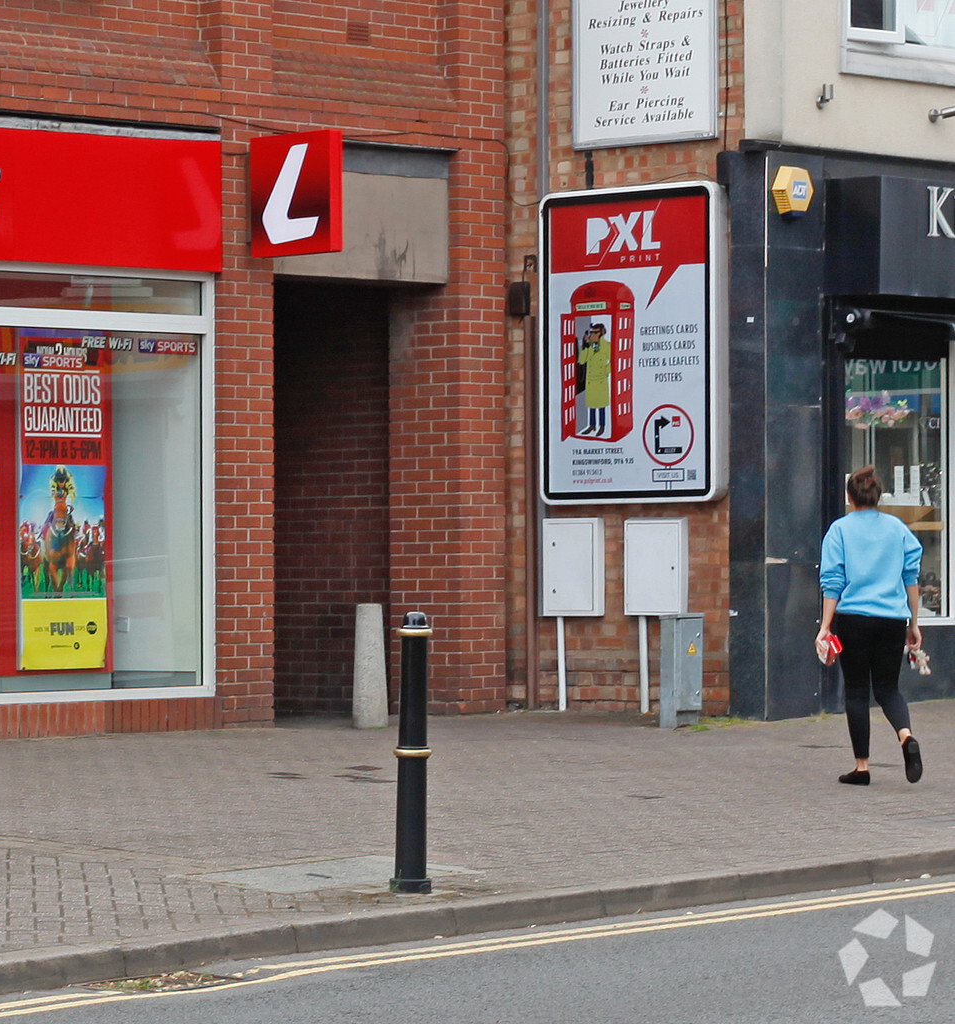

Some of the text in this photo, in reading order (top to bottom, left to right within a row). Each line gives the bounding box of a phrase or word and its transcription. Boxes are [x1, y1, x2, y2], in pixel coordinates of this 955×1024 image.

[588, 7, 703, 29] Resizing & Repairs
[600, 35, 691, 56] Watch Straps &
[599, 50, 693, 70] Batteries Fitted
[601, 65, 690, 85] While You Wait
[608, 95, 685, 112] Ear Piercing
[594, 108, 694, 128] Service Available
[262, 143, 319, 245] L
[792, 184, 807, 197] ADT
[927, 186, 955, 239] K
[586, 210, 661, 256] PXL
[620, 253, 661, 263] PRINT
[640, 323, 698, 336] GREETINGS CARDS
[81, 335, 106, 349] FREE
[139, 340, 196, 353] sky SPORTS
[642, 339, 696, 351] BUSINESS CARDS
[23, 354, 83, 368] sky SPORTS
[638, 355, 700, 367] FLYERS & LEAFLETS
[654, 372, 682, 383] POSTERS
[24, 373, 101, 405] BEST ODDS
[24, 406, 102, 433] GUARANTEED
[25, 439, 101, 459] 12-1PM & 5-6PM
[50, 622, 75, 636] FUN
